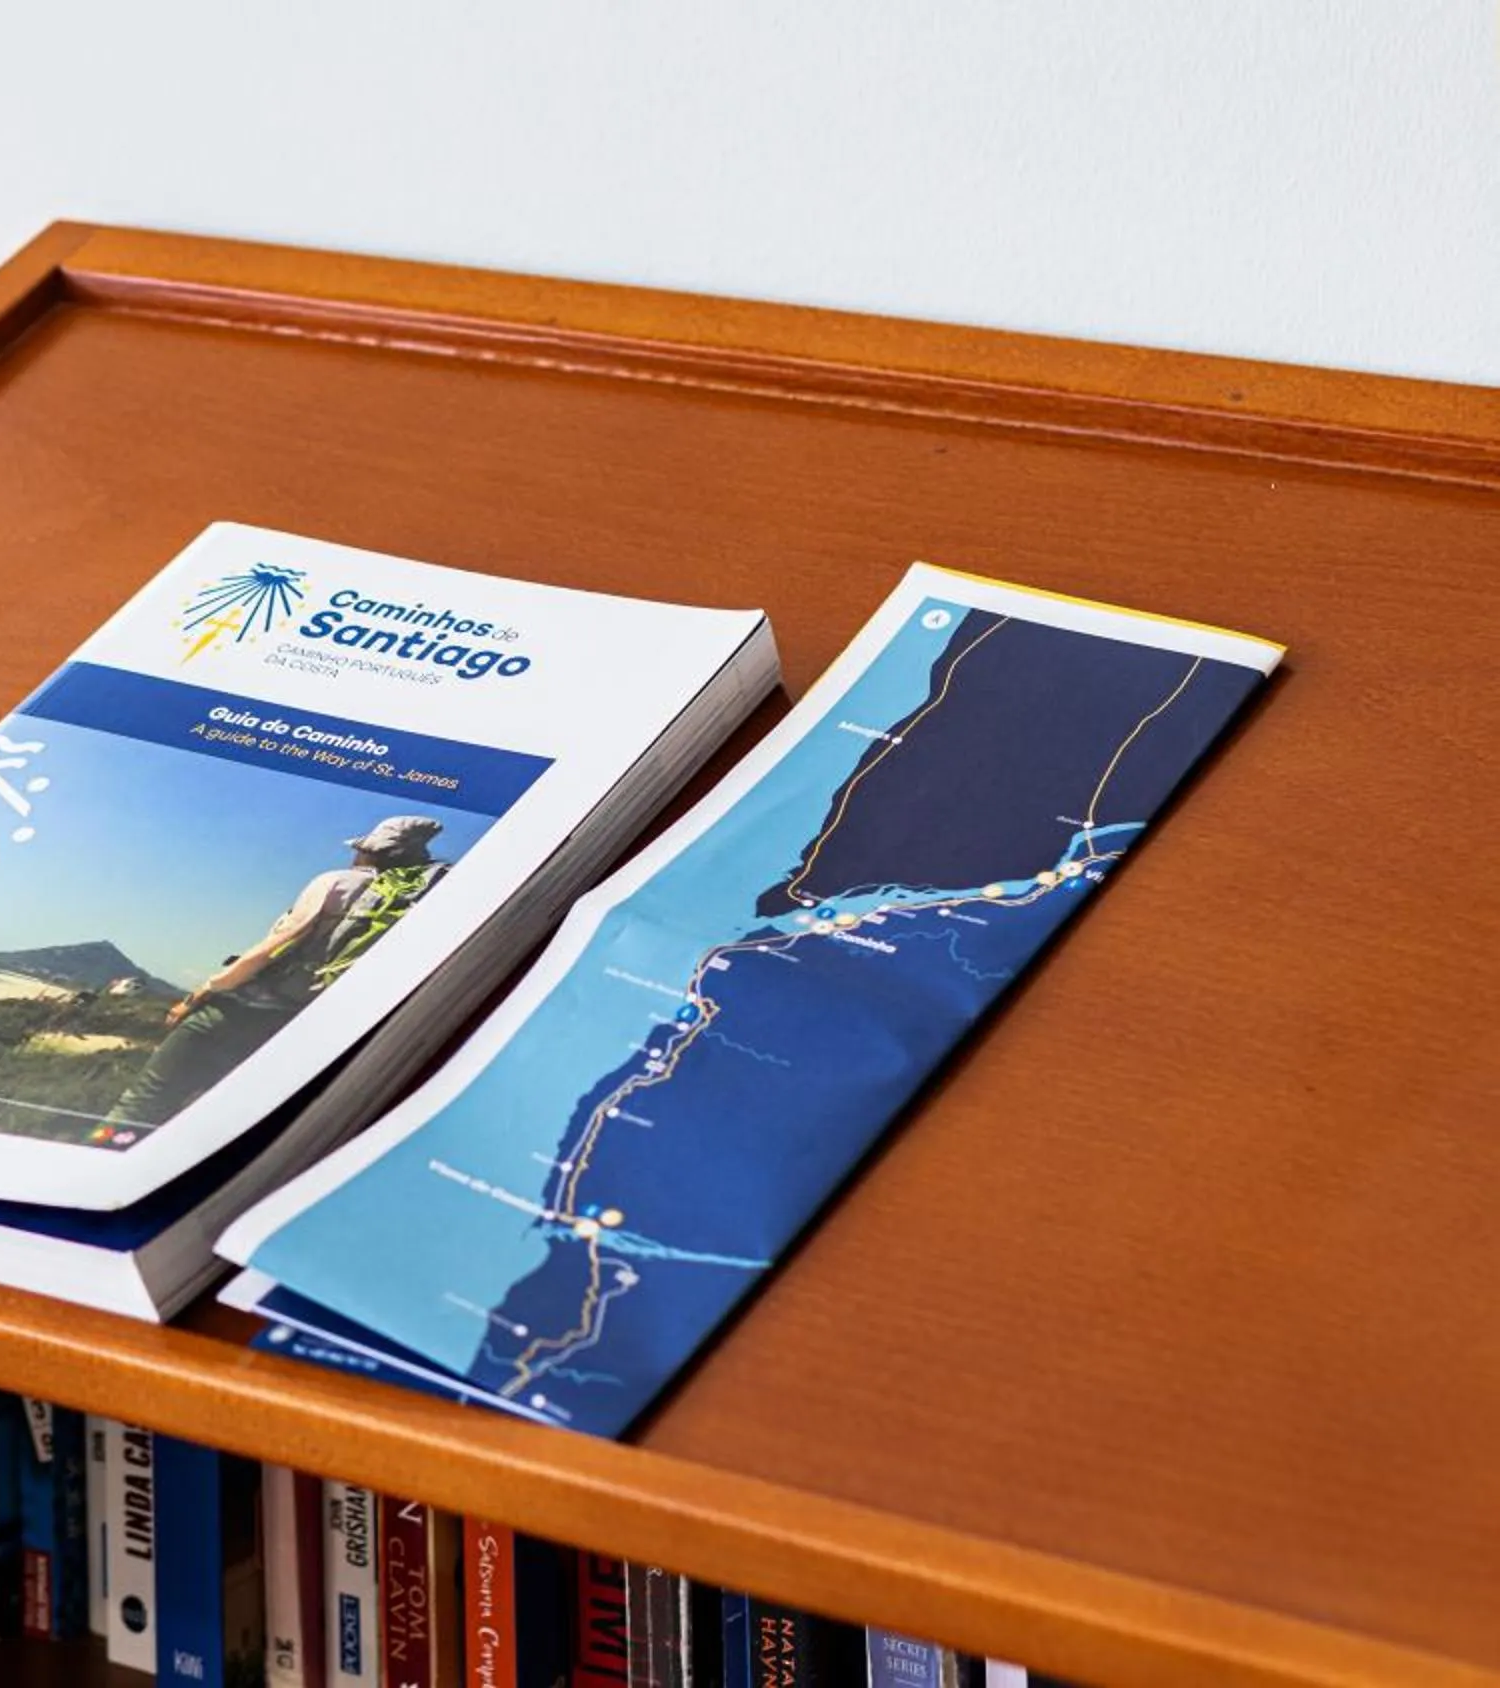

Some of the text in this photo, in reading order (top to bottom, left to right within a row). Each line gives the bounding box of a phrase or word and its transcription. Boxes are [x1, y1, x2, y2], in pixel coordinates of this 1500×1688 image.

[329, 589, 519, 641] Caminhos de
[264, 653, 339, 679] DA COSTA
[277, 643, 443, 685] CAMINHO PORTUGUÊS
[299, 610, 531, 680] Santiago
[190, 723, 460, 790] A guide to the Way of St. James
[208, 706, 389, 756] Guia do Caminho
[124, 1474, 152, 1561] LINDA
[388, 1536, 407, 1662] CLAVIN
[407, 1565, 427, 1640] TOM
[883, 1637, 928, 1661] SECRET
[885, 1656, 928, 1679] SERIES
